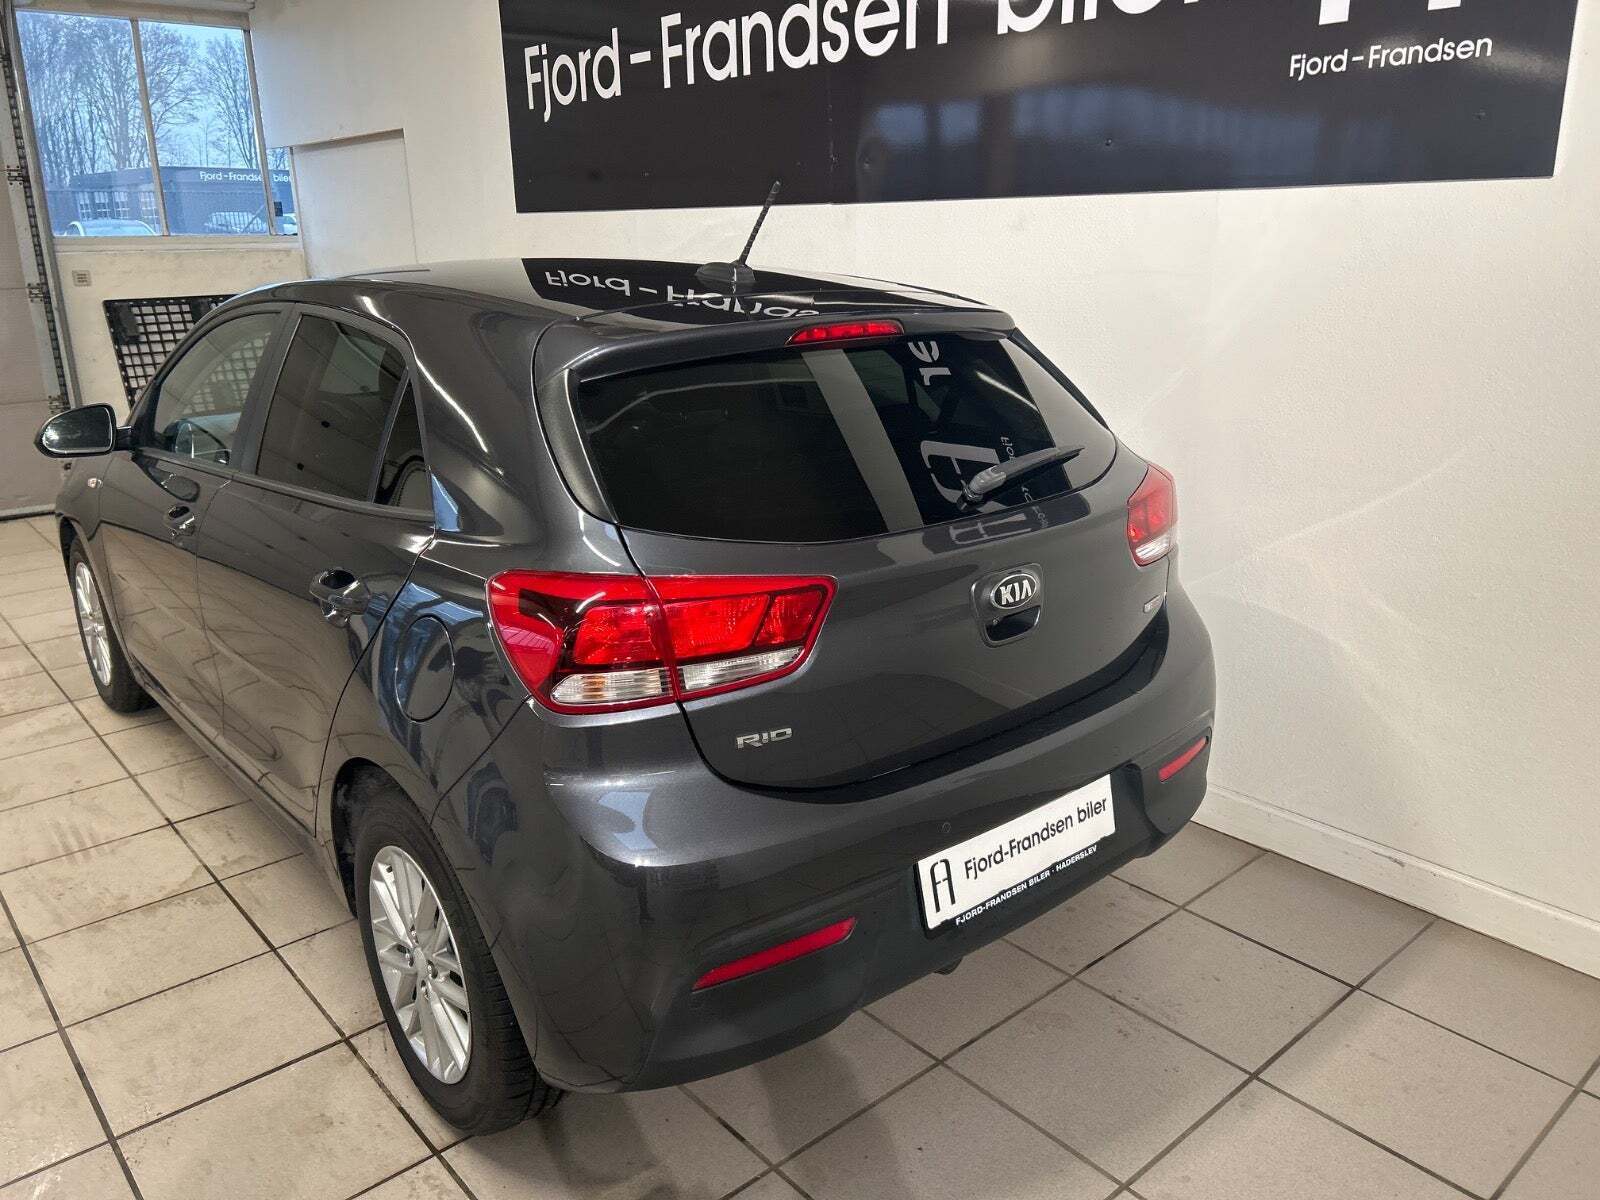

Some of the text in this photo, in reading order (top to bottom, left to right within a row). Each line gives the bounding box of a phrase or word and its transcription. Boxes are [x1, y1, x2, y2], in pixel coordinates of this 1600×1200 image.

[1000, 579, 1032, 605] KIA
[736, 727, 793, 749] RIO
[963, 798, 1107, 880] Fjord-Frandsen biler
[955, 844, 1098, 926] FJORD-FRANDSEN BILER HADERSLEV
